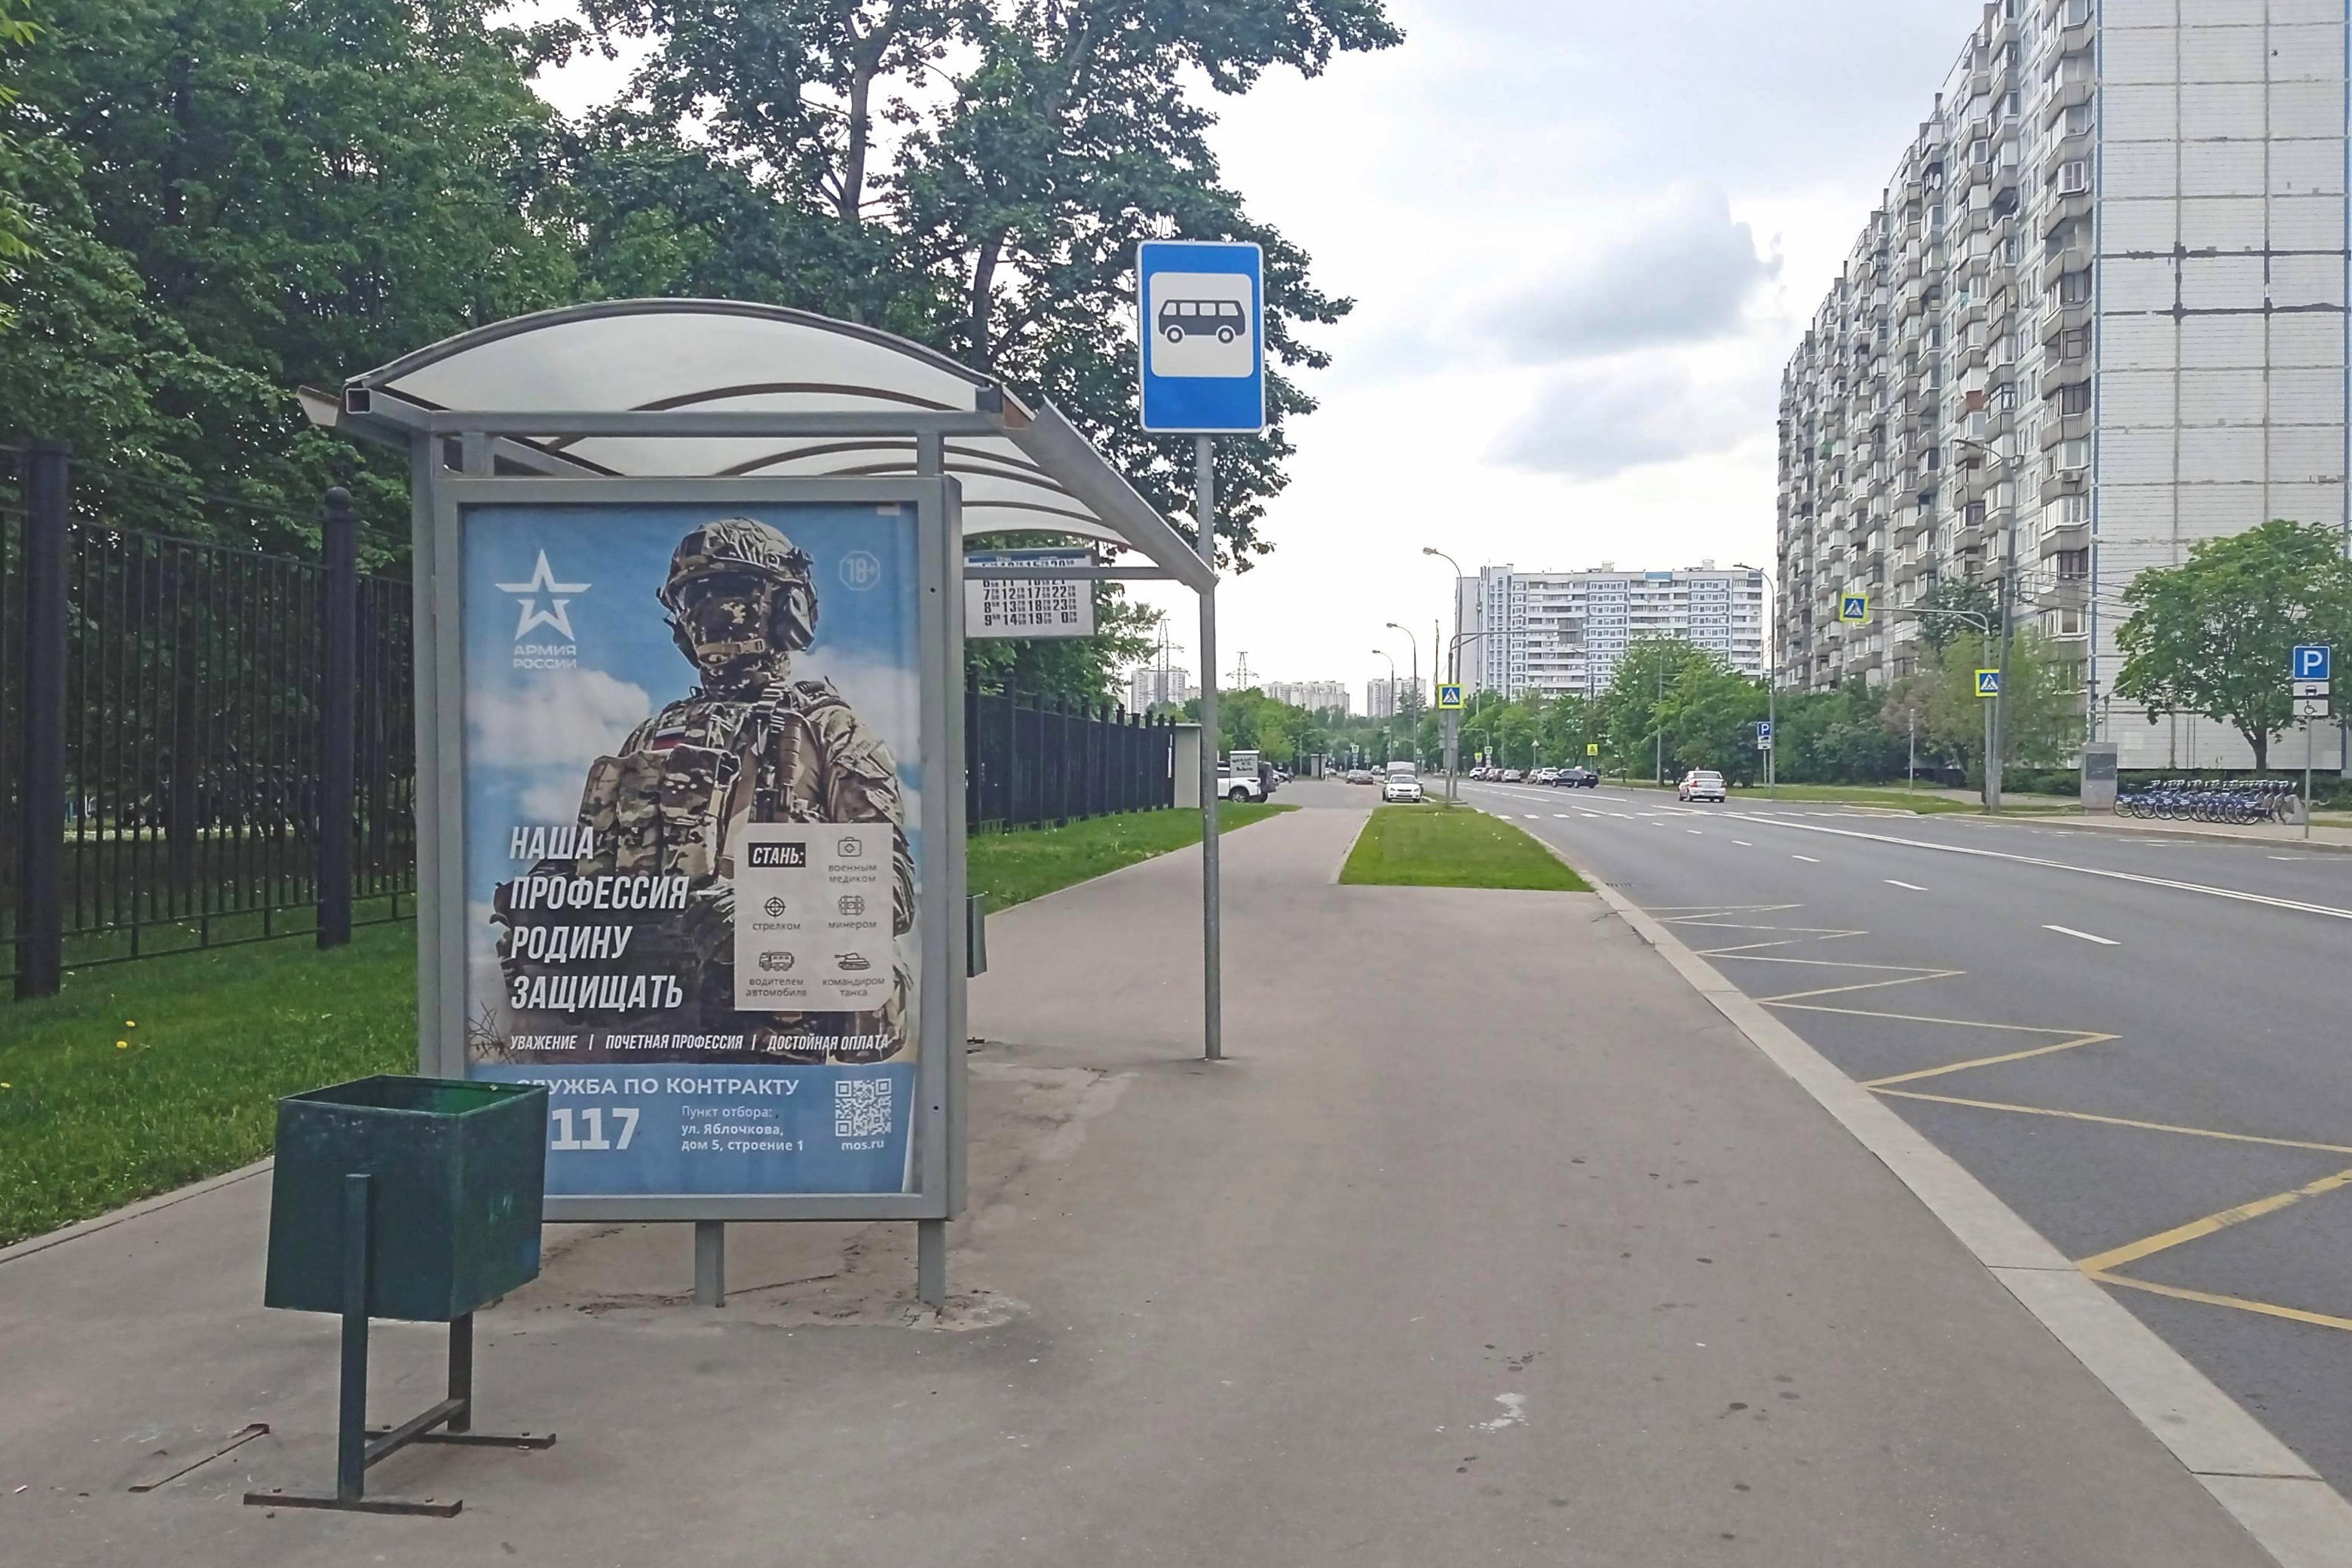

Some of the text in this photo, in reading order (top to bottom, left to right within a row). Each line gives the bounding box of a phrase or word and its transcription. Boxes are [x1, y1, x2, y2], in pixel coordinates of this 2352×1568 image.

[847, 558, 875, 583] 18+
[984, 589, 990, 600] 7
[1002, 588, 1015, 599] 12
[1027, 587, 1040, 599] 17
[1052, 586, 1067, 598] 22
[985, 602, 991, 613] 8
[1003, 601, 1016, 612] 13
[1028, 600, 1042, 611] 18
[1053, 599, 1067, 611] 23
[985, 615, 992, 626] 9
[1003, 614, 1017, 625] 14
[1028, 613, 1043, 624] 19
[513, 645, 577, 655] АРМИЯ
[513, 658, 577, 669] РОССИИ
[2303, 651, 2323, 675] P
[1761, 724, 1769, 734] P
[510, 826, 594, 859] НАША
[753, 847, 804, 865] СТАНЬ:
[829, 875, 876, 884] медиком
[510, 876, 690, 909] ПРОФЕССИЯ
[752, 921, 801, 932] стрелком
[828, 921, 877, 929] минером
[511, 926, 633, 963] РОДИНУ
[749, 978, 804, 986] водителем
[822, 977, 885, 987] командиром
[511, 975, 683, 1012] ЗАЩИЩАТЬ
[746, 988, 807, 997] автомобиля
[840, 988, 868, 997] танка
[510, 1035, 577, 1050] УВАЖЕНИЕ
[605, 1034, 743, 1049] ПОЧЕТНАЯ ПРОФЕССИЯ
[767, 1033, 890, 1051] ДОСТОЙНАЯ ОПЛАТА
[624, 1078, 659, 1094] ПО
[666, 1078, 799, 1095] КОНТРАКТУ
[681, 1106, 773, 1119] Пункт отбора:
[551, 1107, 639, 1150] 117
[681, 1124, 784, 1137] ул. Яблочкова,
[681, 1140, 804, 1153] дом 5, строение 1
[841, 1140, 884, 1150] mos.ru
